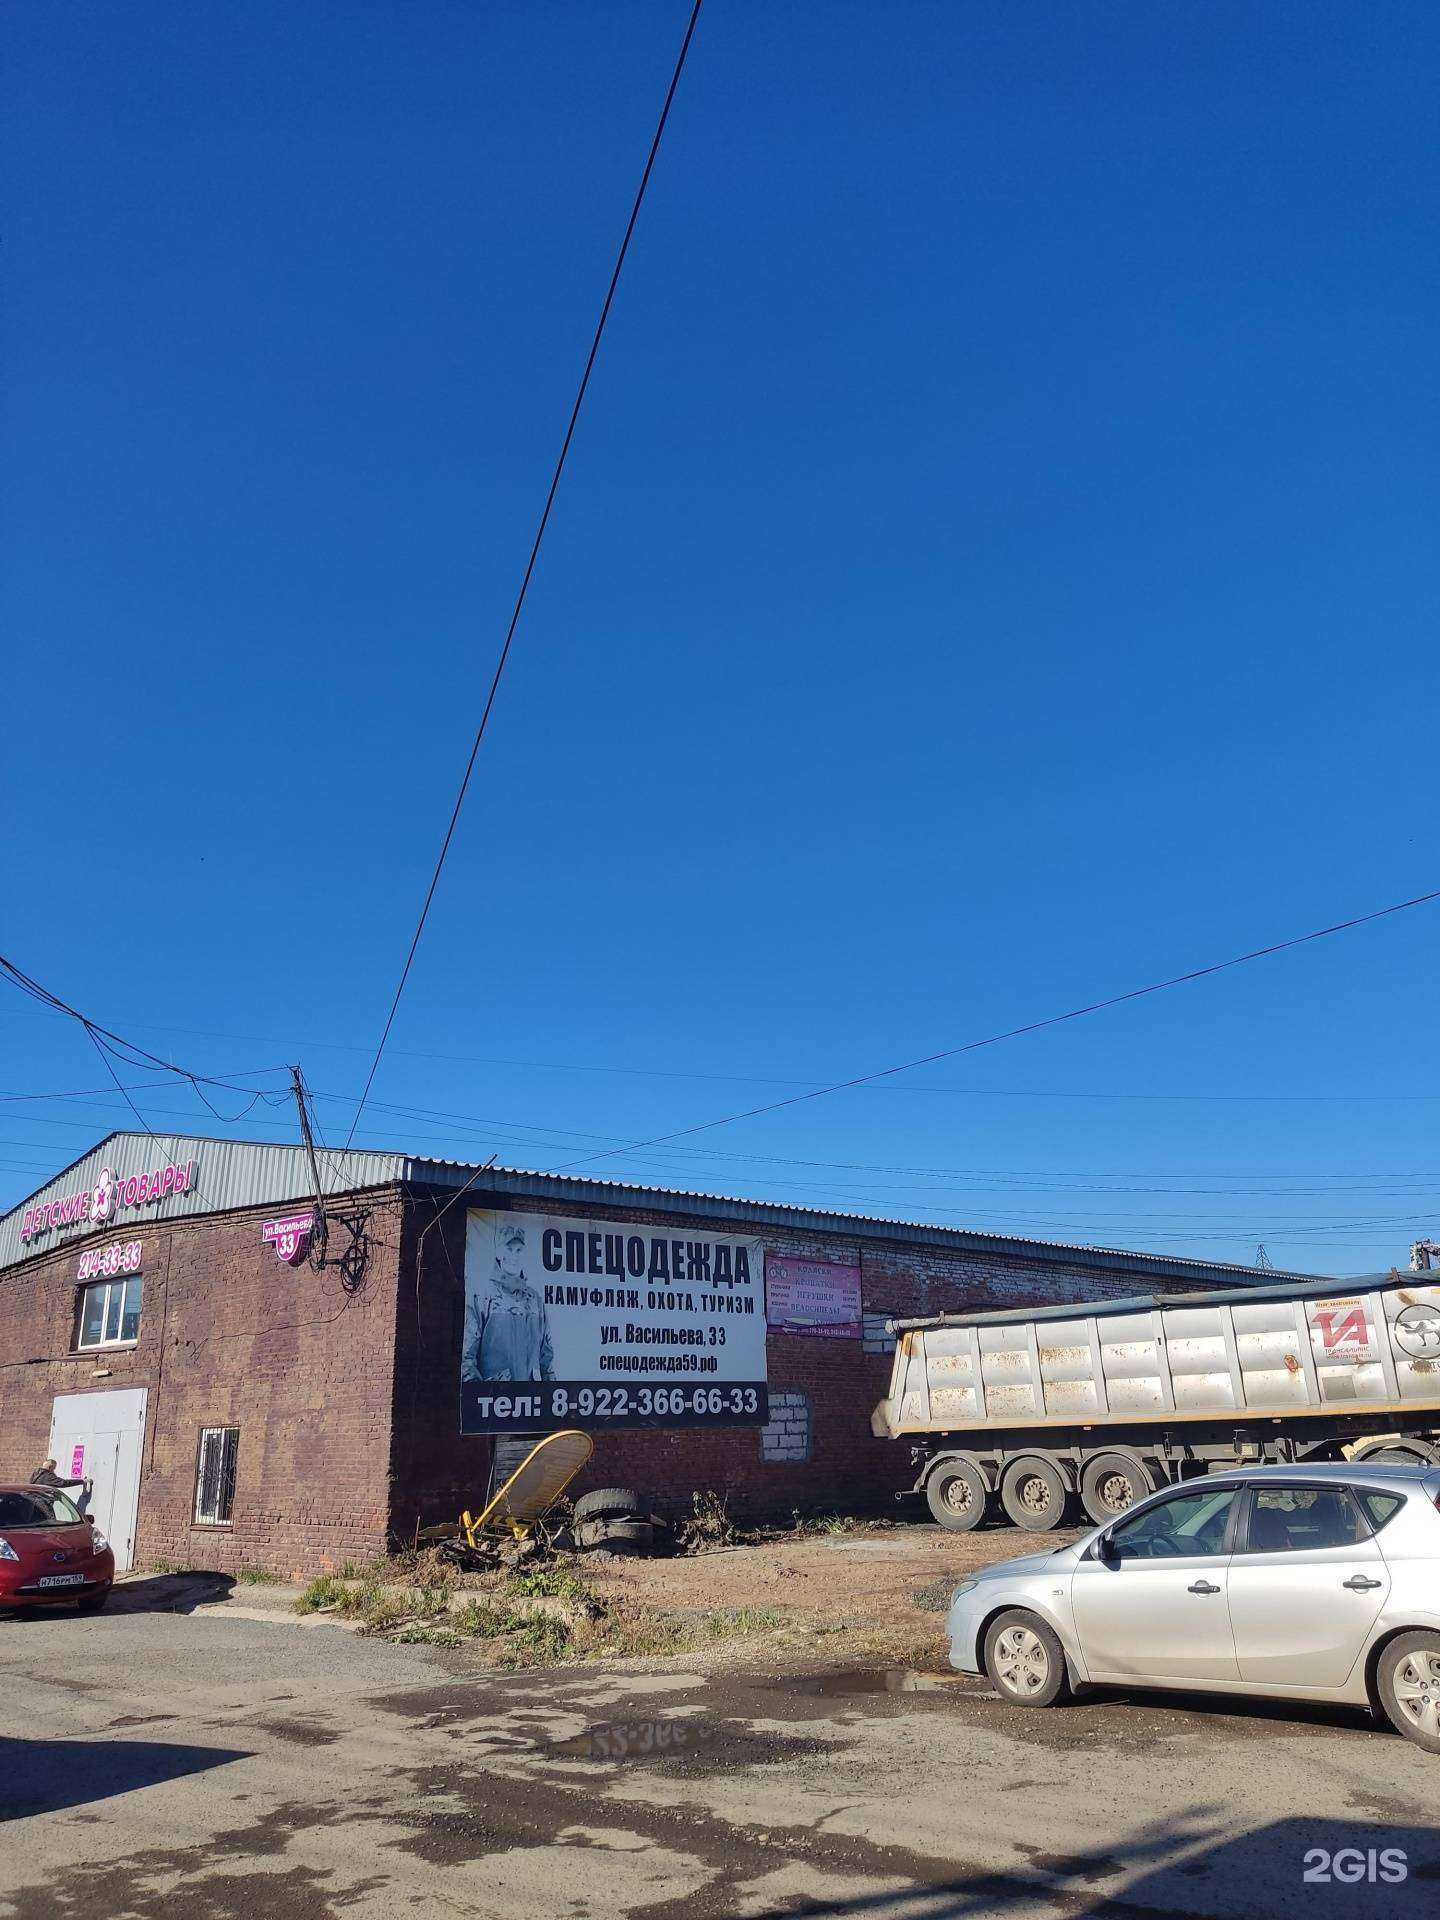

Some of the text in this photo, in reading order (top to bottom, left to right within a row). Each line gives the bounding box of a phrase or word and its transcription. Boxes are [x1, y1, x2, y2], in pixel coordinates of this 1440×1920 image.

[19, 1159, 193, 1243] ДЕТСКИЕ ТОВАРЫ
[279, 1233, 295, 1255] 33
[542, 1228, 751, 1289] СПЕЦОДЕЖДА
[77, 1241, 142, 1280] 214-33-33
[544, 1285, 643, 1310] КАМУФЛЯЖ,
[647, 1291, 698, 1313] ОХОТА,
[701, 1294, 754, 1314] ТУРИЗМ
[600, 1323, 726, 1346] ул. Васильева, 33
[599, 1354, 718, 1374] спецодежда59.рф
[477, 1388, 758, 1418] тел: 8-922-366-66-33
